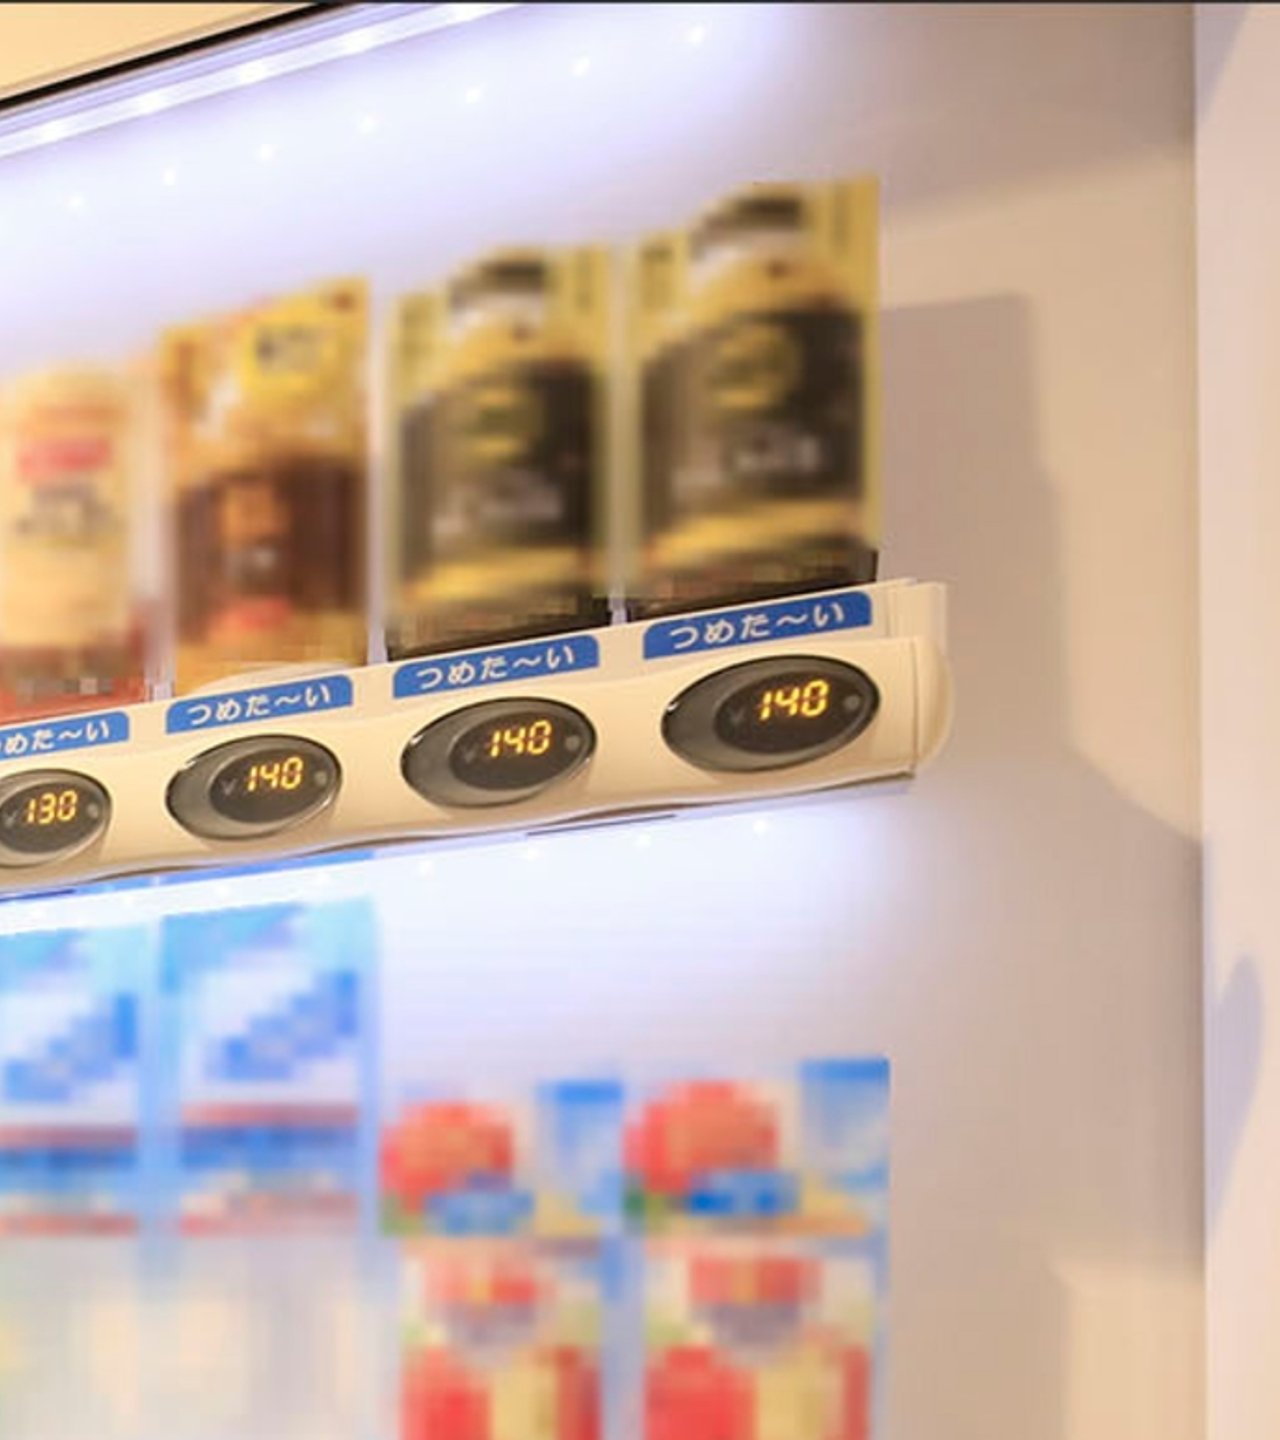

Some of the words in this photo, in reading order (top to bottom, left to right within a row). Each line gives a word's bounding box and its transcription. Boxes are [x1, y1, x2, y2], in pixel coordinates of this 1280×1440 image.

[754, 679, 830, 721] 140
[485, 720, 550, 758] 140
[243, 757, 304, 793] 140
[21, 789, 77, 825] 130
